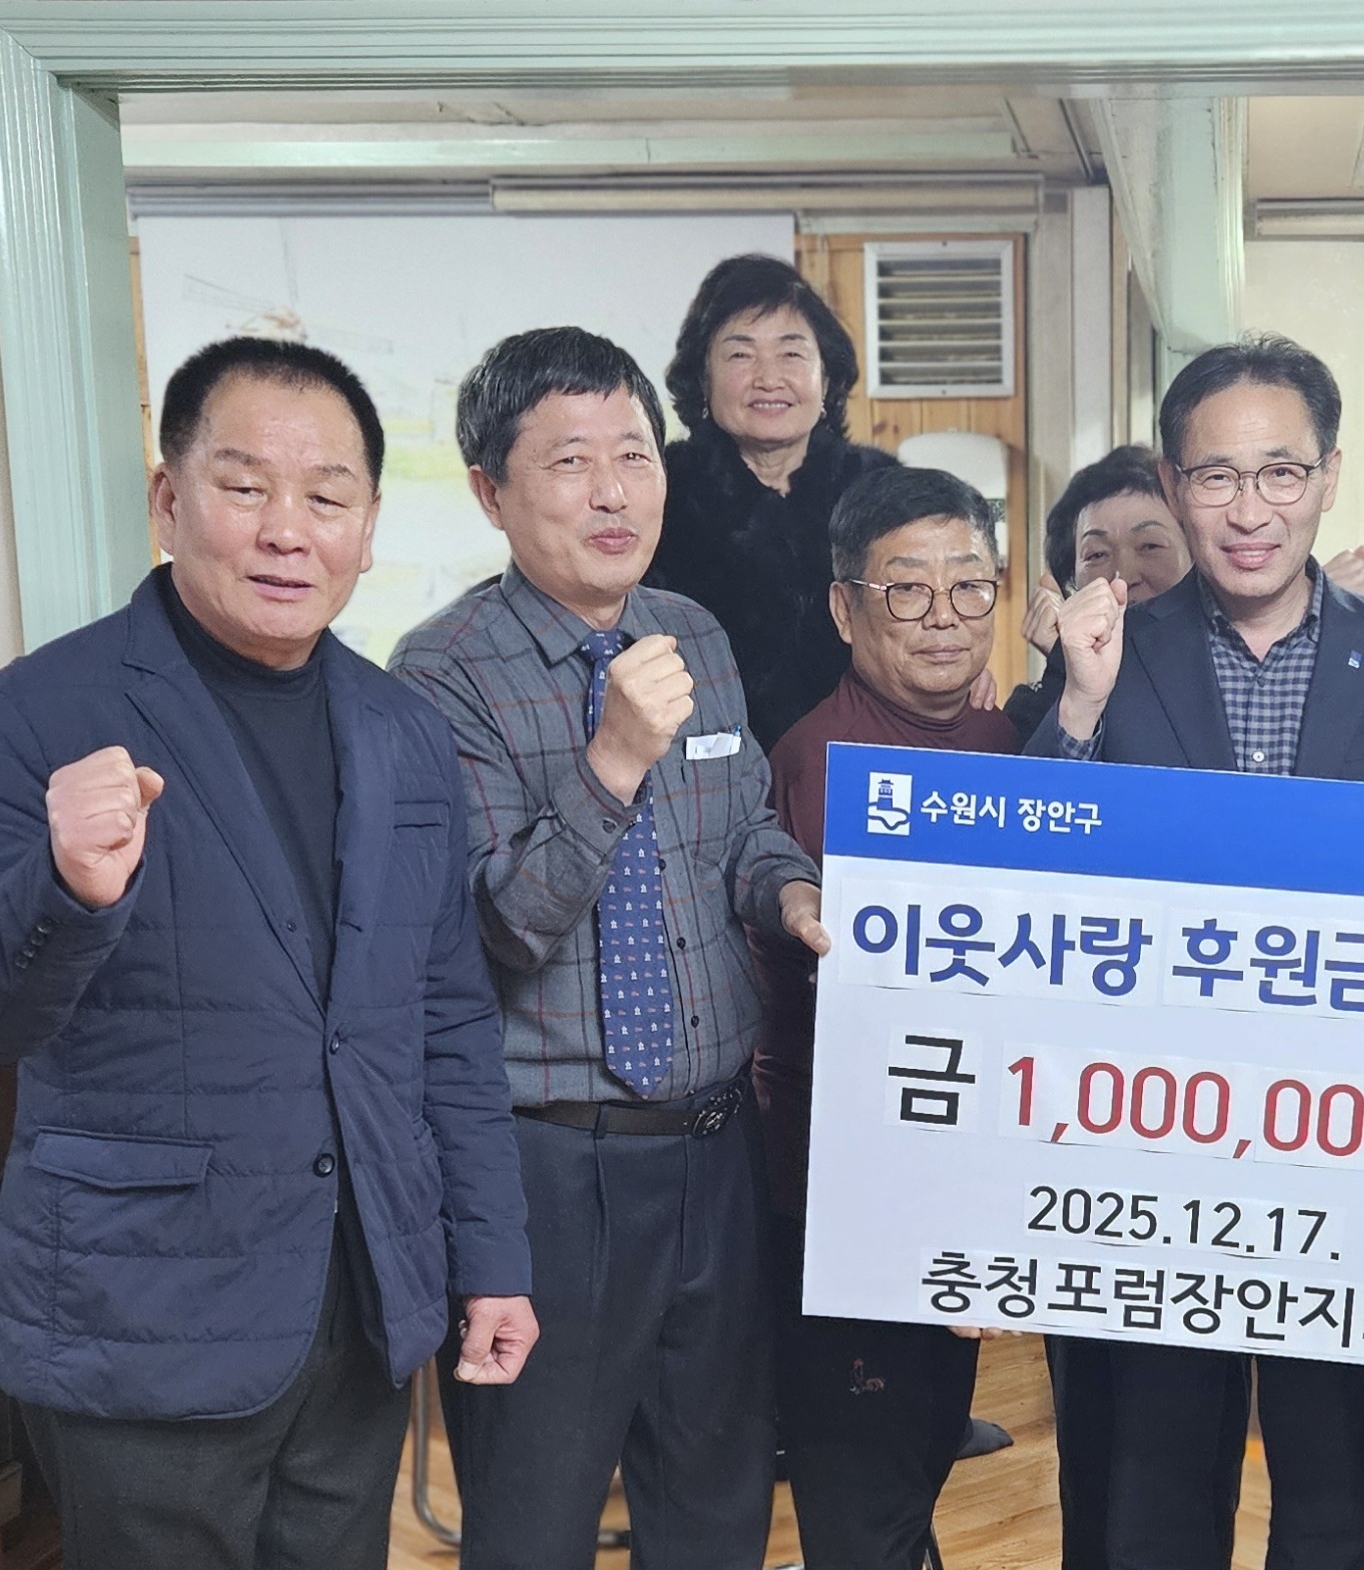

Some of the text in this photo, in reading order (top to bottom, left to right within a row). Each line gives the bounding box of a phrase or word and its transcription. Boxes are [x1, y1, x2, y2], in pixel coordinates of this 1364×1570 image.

[921, 792, 1102, 834] 수원시 장안구
[852, 903, 1152, 997] 이웃사랑
[888, 1034, 976, 1125] 금
[1027, 1186, 1341, 1261] 2025.12.17.
